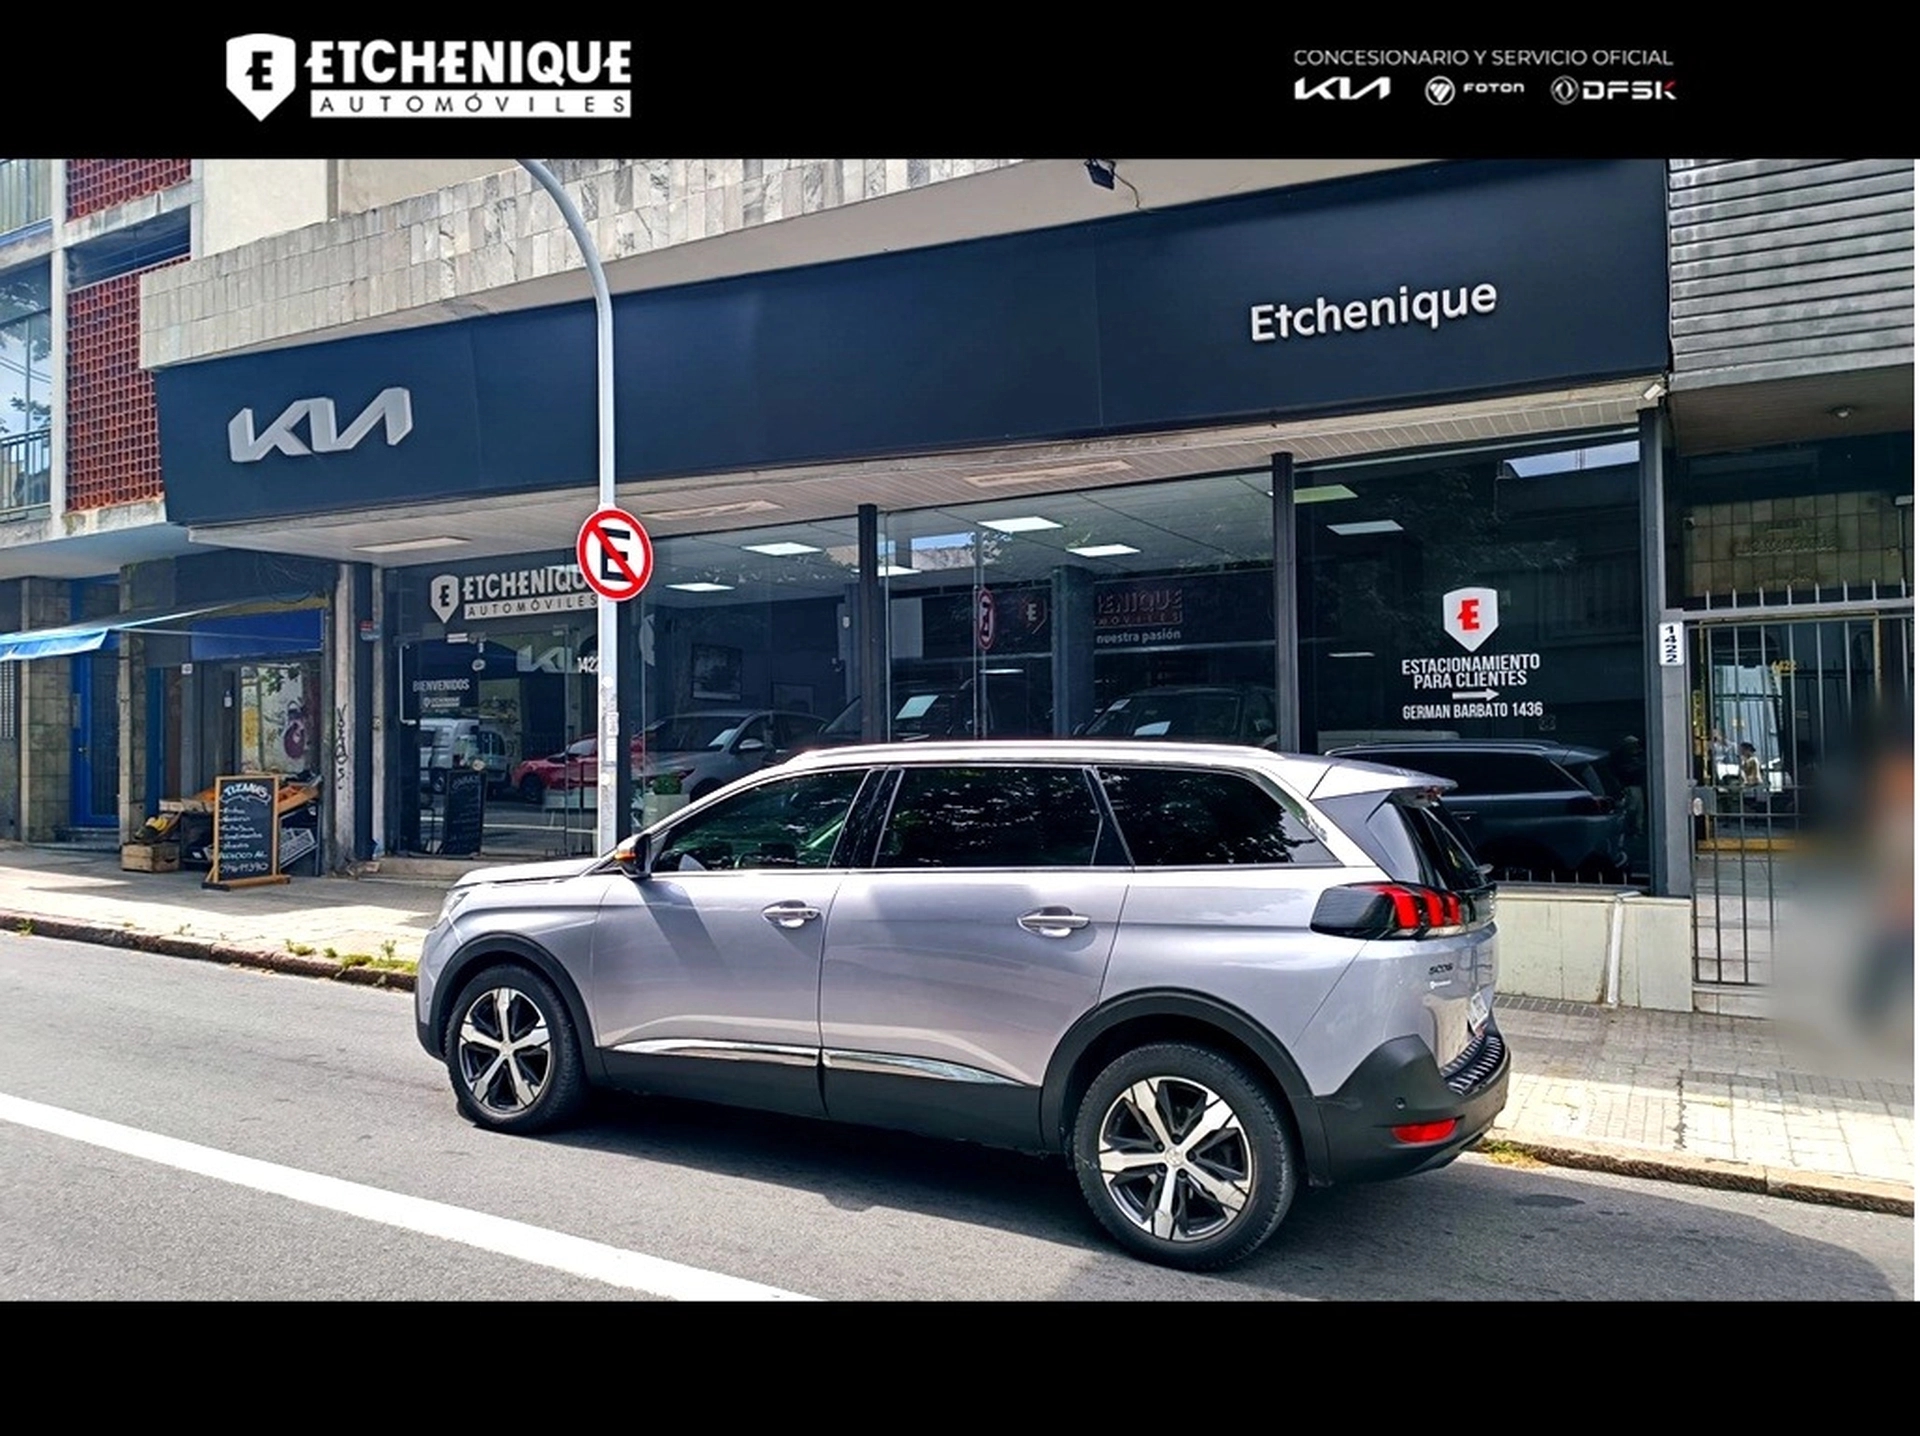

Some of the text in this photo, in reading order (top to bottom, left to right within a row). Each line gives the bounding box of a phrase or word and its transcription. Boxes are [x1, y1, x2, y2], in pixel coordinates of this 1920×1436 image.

[1251, 283, 1498, 342] Etchenique
[228, 387, 413, 462] KIA
[600, 527, 631, 582] E
[462, 568, 587, 600] ETCHENIQU
[1097, 629, 1181, 644] nuestra pasión
[1402, 654, 1540, 675] ESTACIONAMIENTO
[1414, 671, 1527, 690] PARA CLIENTES
[1402, 701, 1544, 719] GERMAN BARBATO 1436
